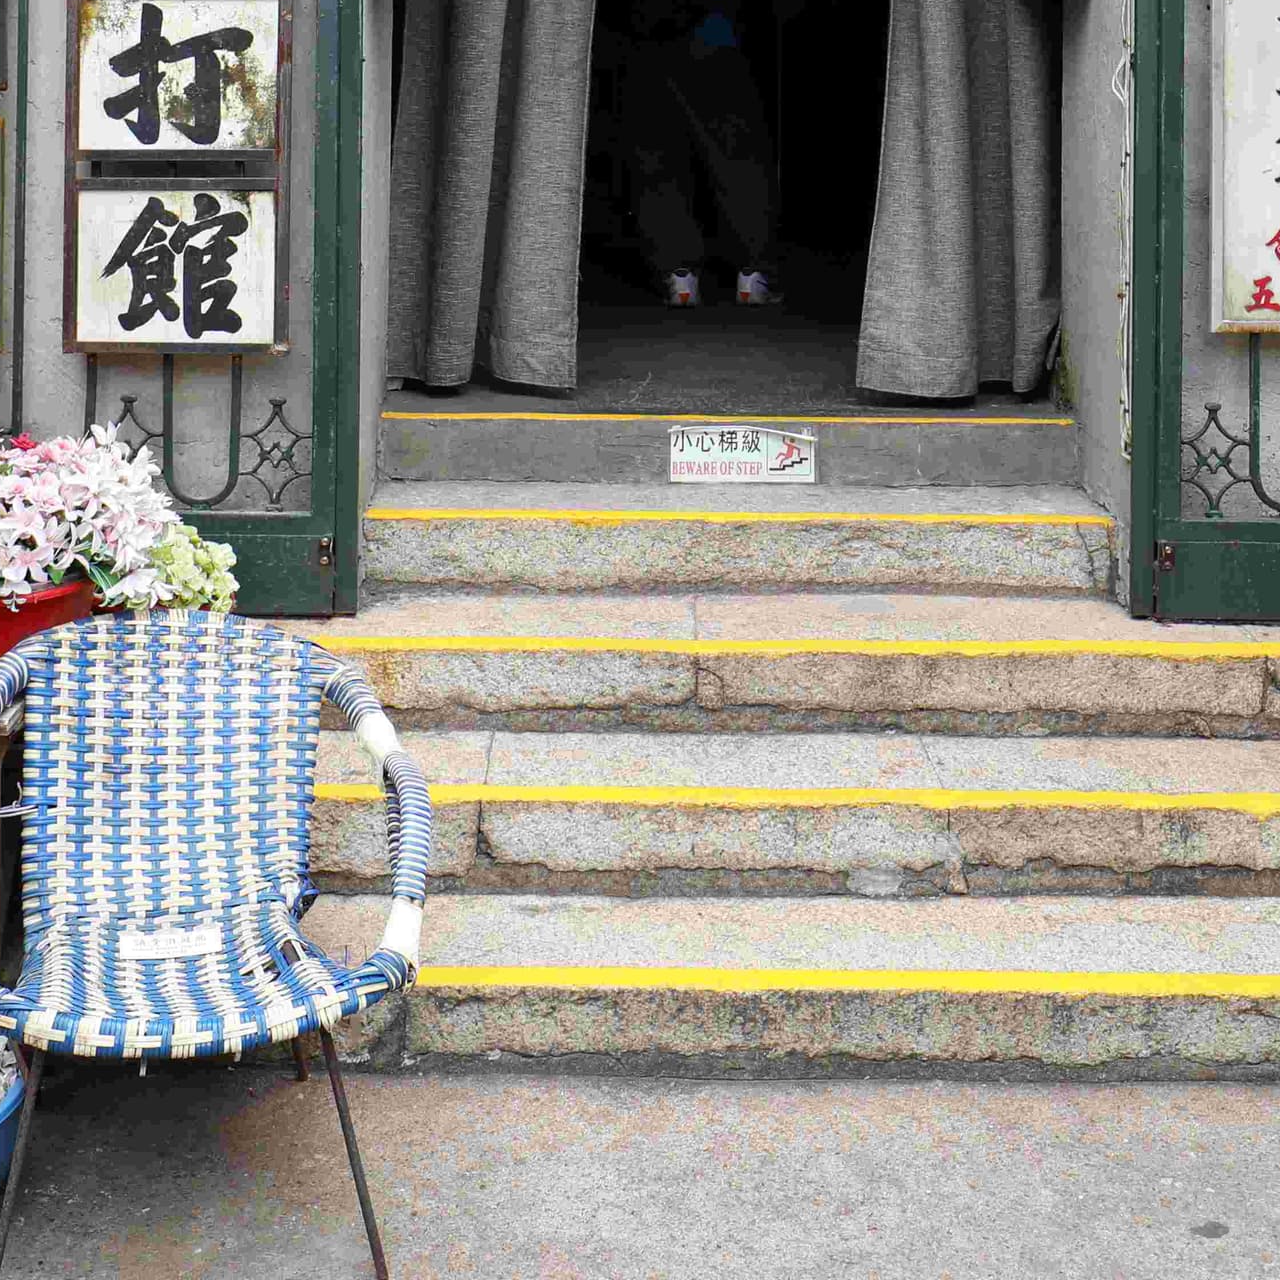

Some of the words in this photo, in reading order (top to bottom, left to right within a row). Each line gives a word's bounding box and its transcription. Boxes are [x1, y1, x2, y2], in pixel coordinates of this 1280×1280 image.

[671, 429, 762, 455] 小心梯級
[671, 460, 717, 477] BEWARE
[718, 460, 735, 477] OF
[735, 460, 763, 477] STEP
